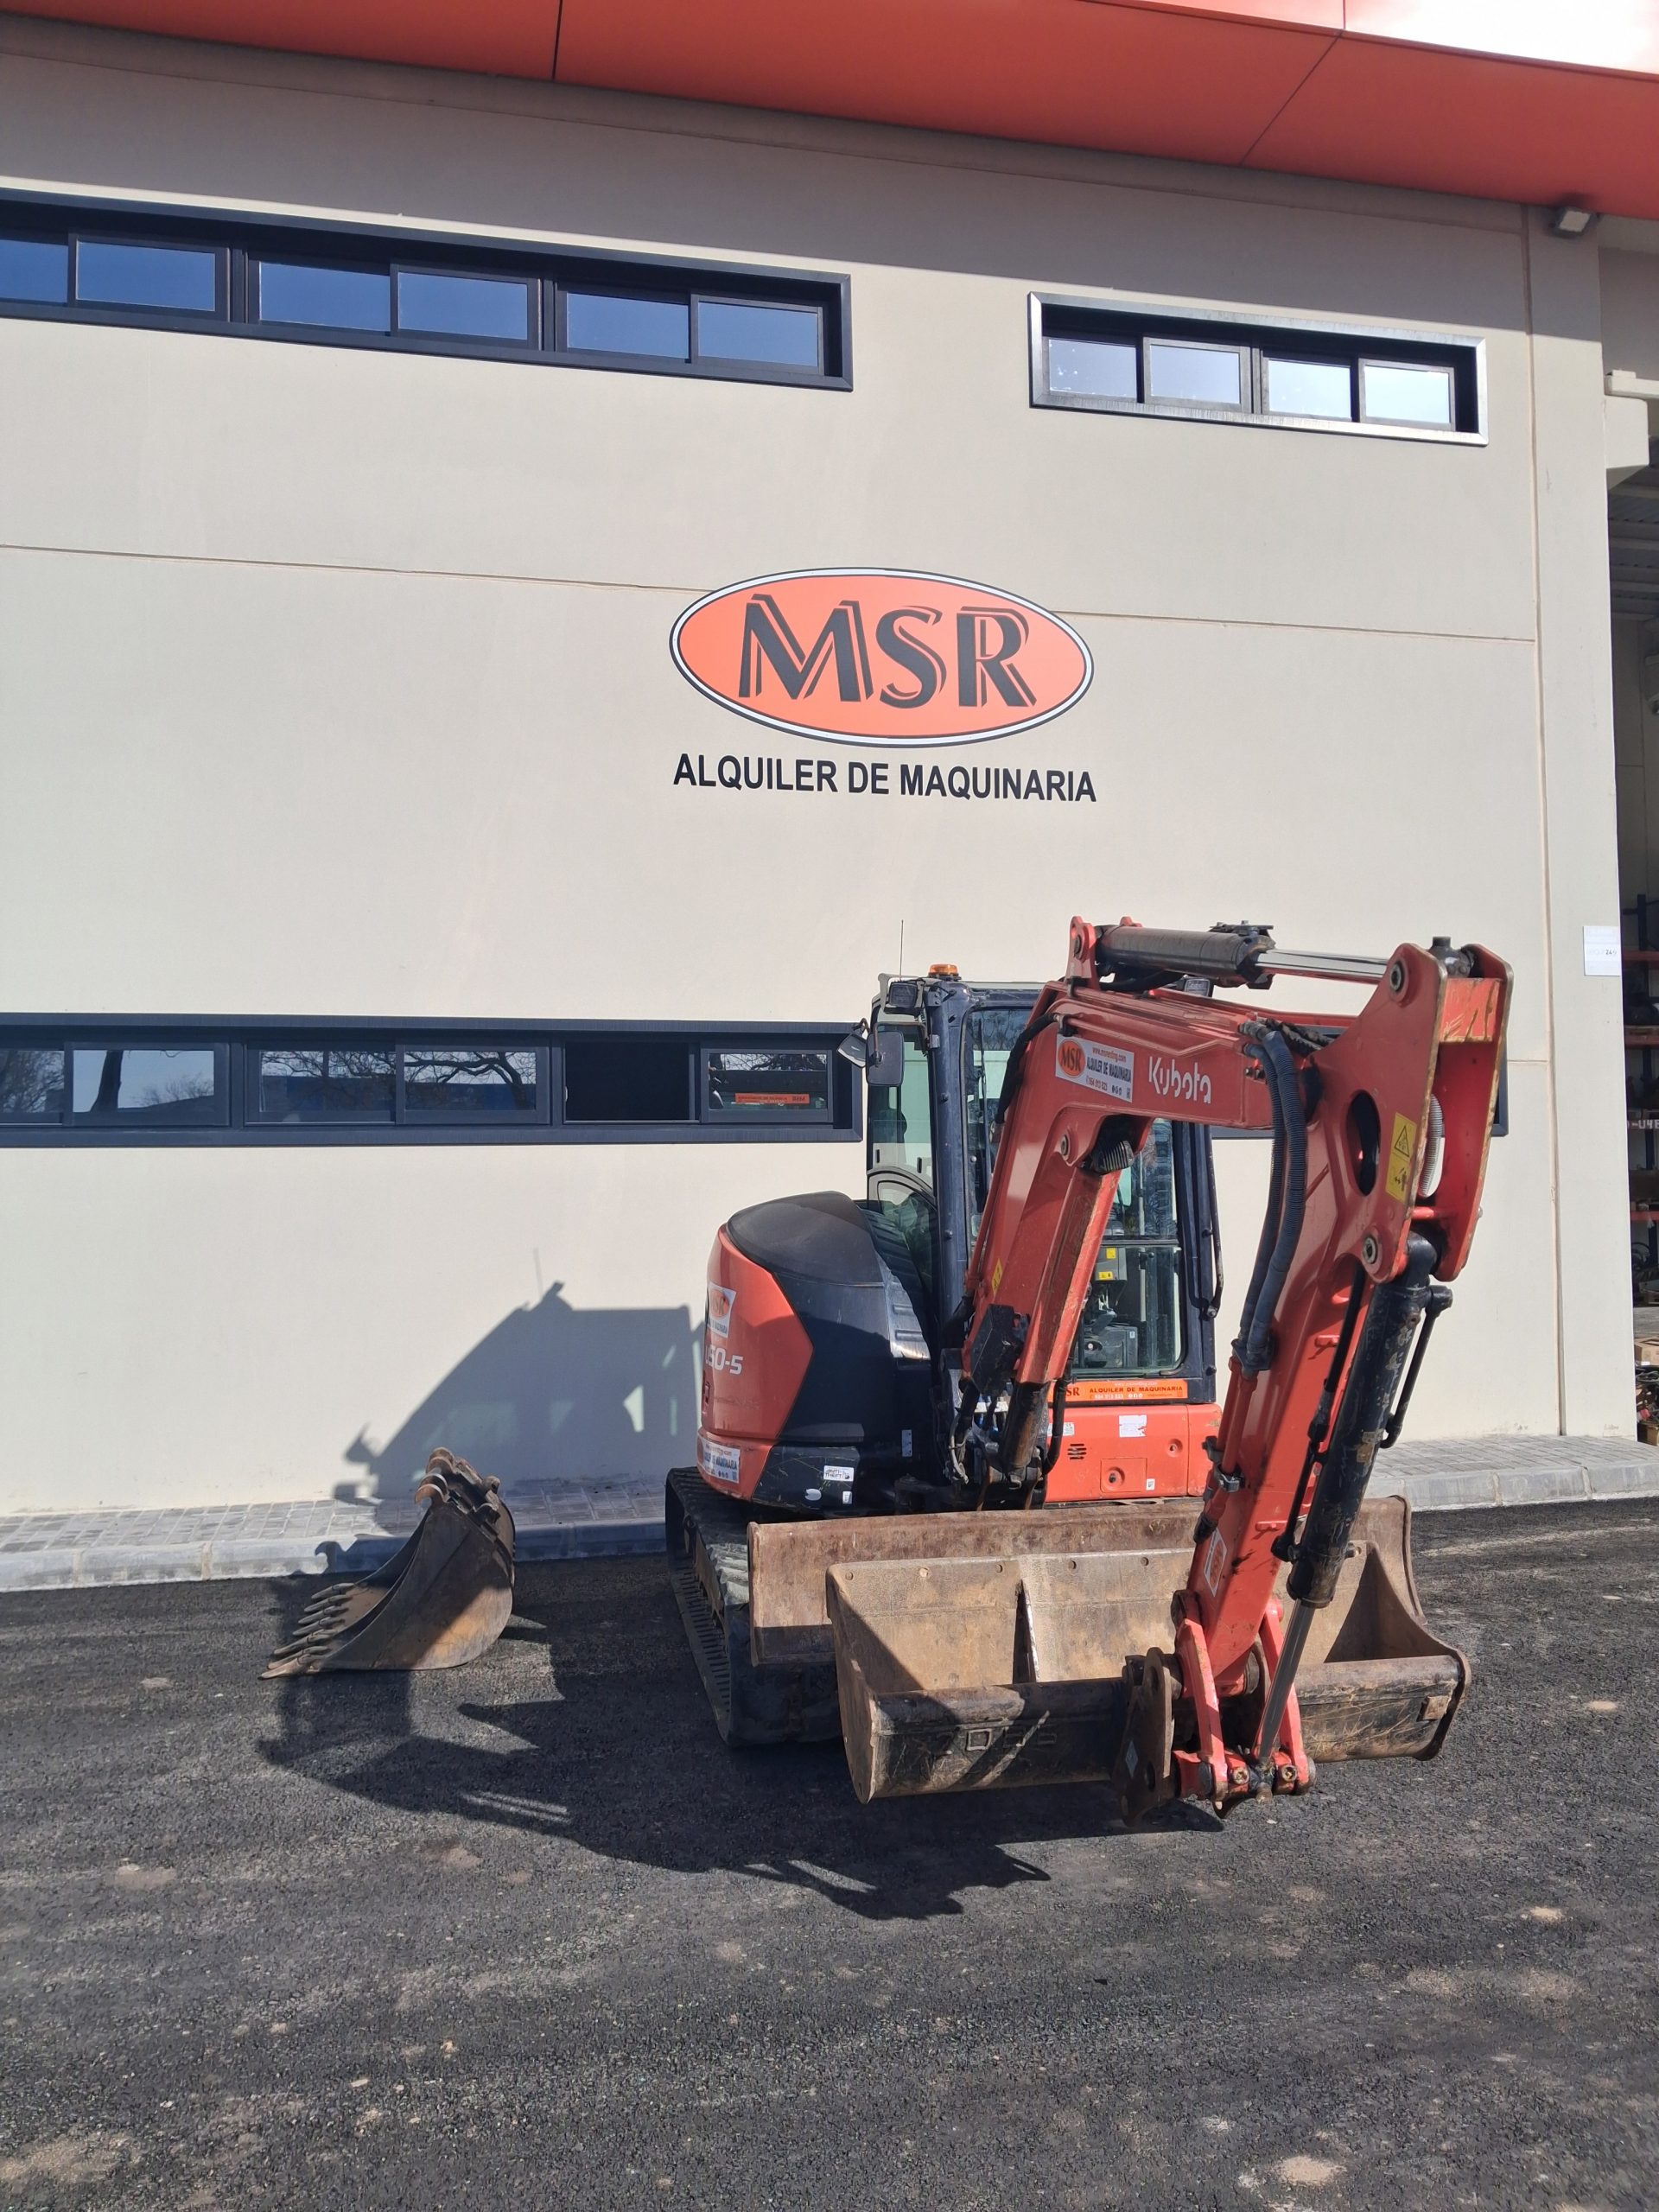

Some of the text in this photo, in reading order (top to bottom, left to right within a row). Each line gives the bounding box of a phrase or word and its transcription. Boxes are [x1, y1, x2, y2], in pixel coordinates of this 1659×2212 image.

[739, 594, 1037, 709] MSR
[673, 753, 1096, 803] ALQUILER DE MAQUINARIA
[1061, 1046, 1081, 1071] MSR
[1086, 1056, 1132, 1083] ALQUILER DE MAQUINARIA
[1148, 1056, 1211, 1103] Kubota
[1065, 1387, 1080, 1396] SR
